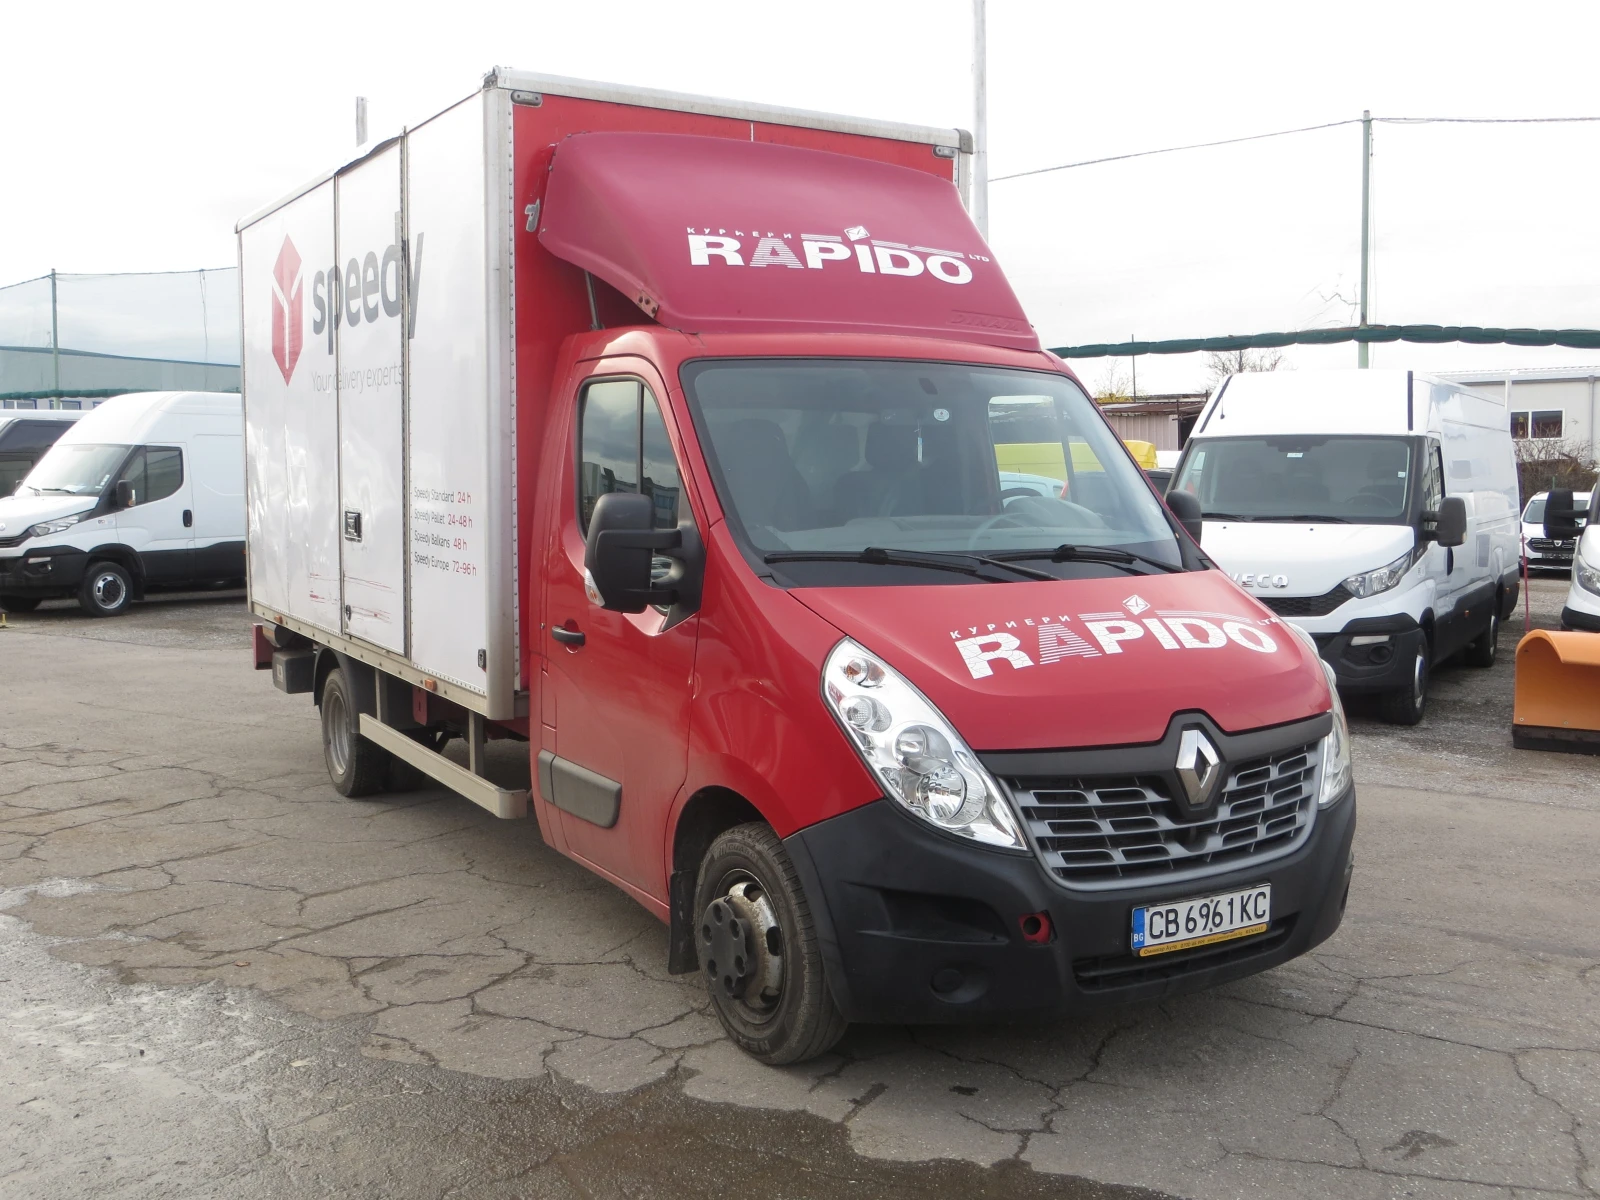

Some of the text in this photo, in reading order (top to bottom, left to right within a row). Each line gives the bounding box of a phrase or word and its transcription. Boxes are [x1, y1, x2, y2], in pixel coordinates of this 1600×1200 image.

[687, 232, 989, 285] RAPIDO LTD
[312, 210, 425, 356] speedy
[311, 361, 403, 394] Your delivery experts
[414, 486, 472, 505] Speedy Standard 24 h
[414, 508, 473, 528] Speedy Pallet 24-48 h
[414, 530, 468, 551] Speedy Balkans 48 h
[414, 551, 477, 577] Speedy Europe 72-96 h
[1228, 572, 1289, 589] VECO
[950, 614, 1072, 640] КУРИЕРИ
[953, 617, 1279, 681] RAPIDO
[1184, 897, 1234, 934] 6961
[1133, 932, 1144, 943] BG
